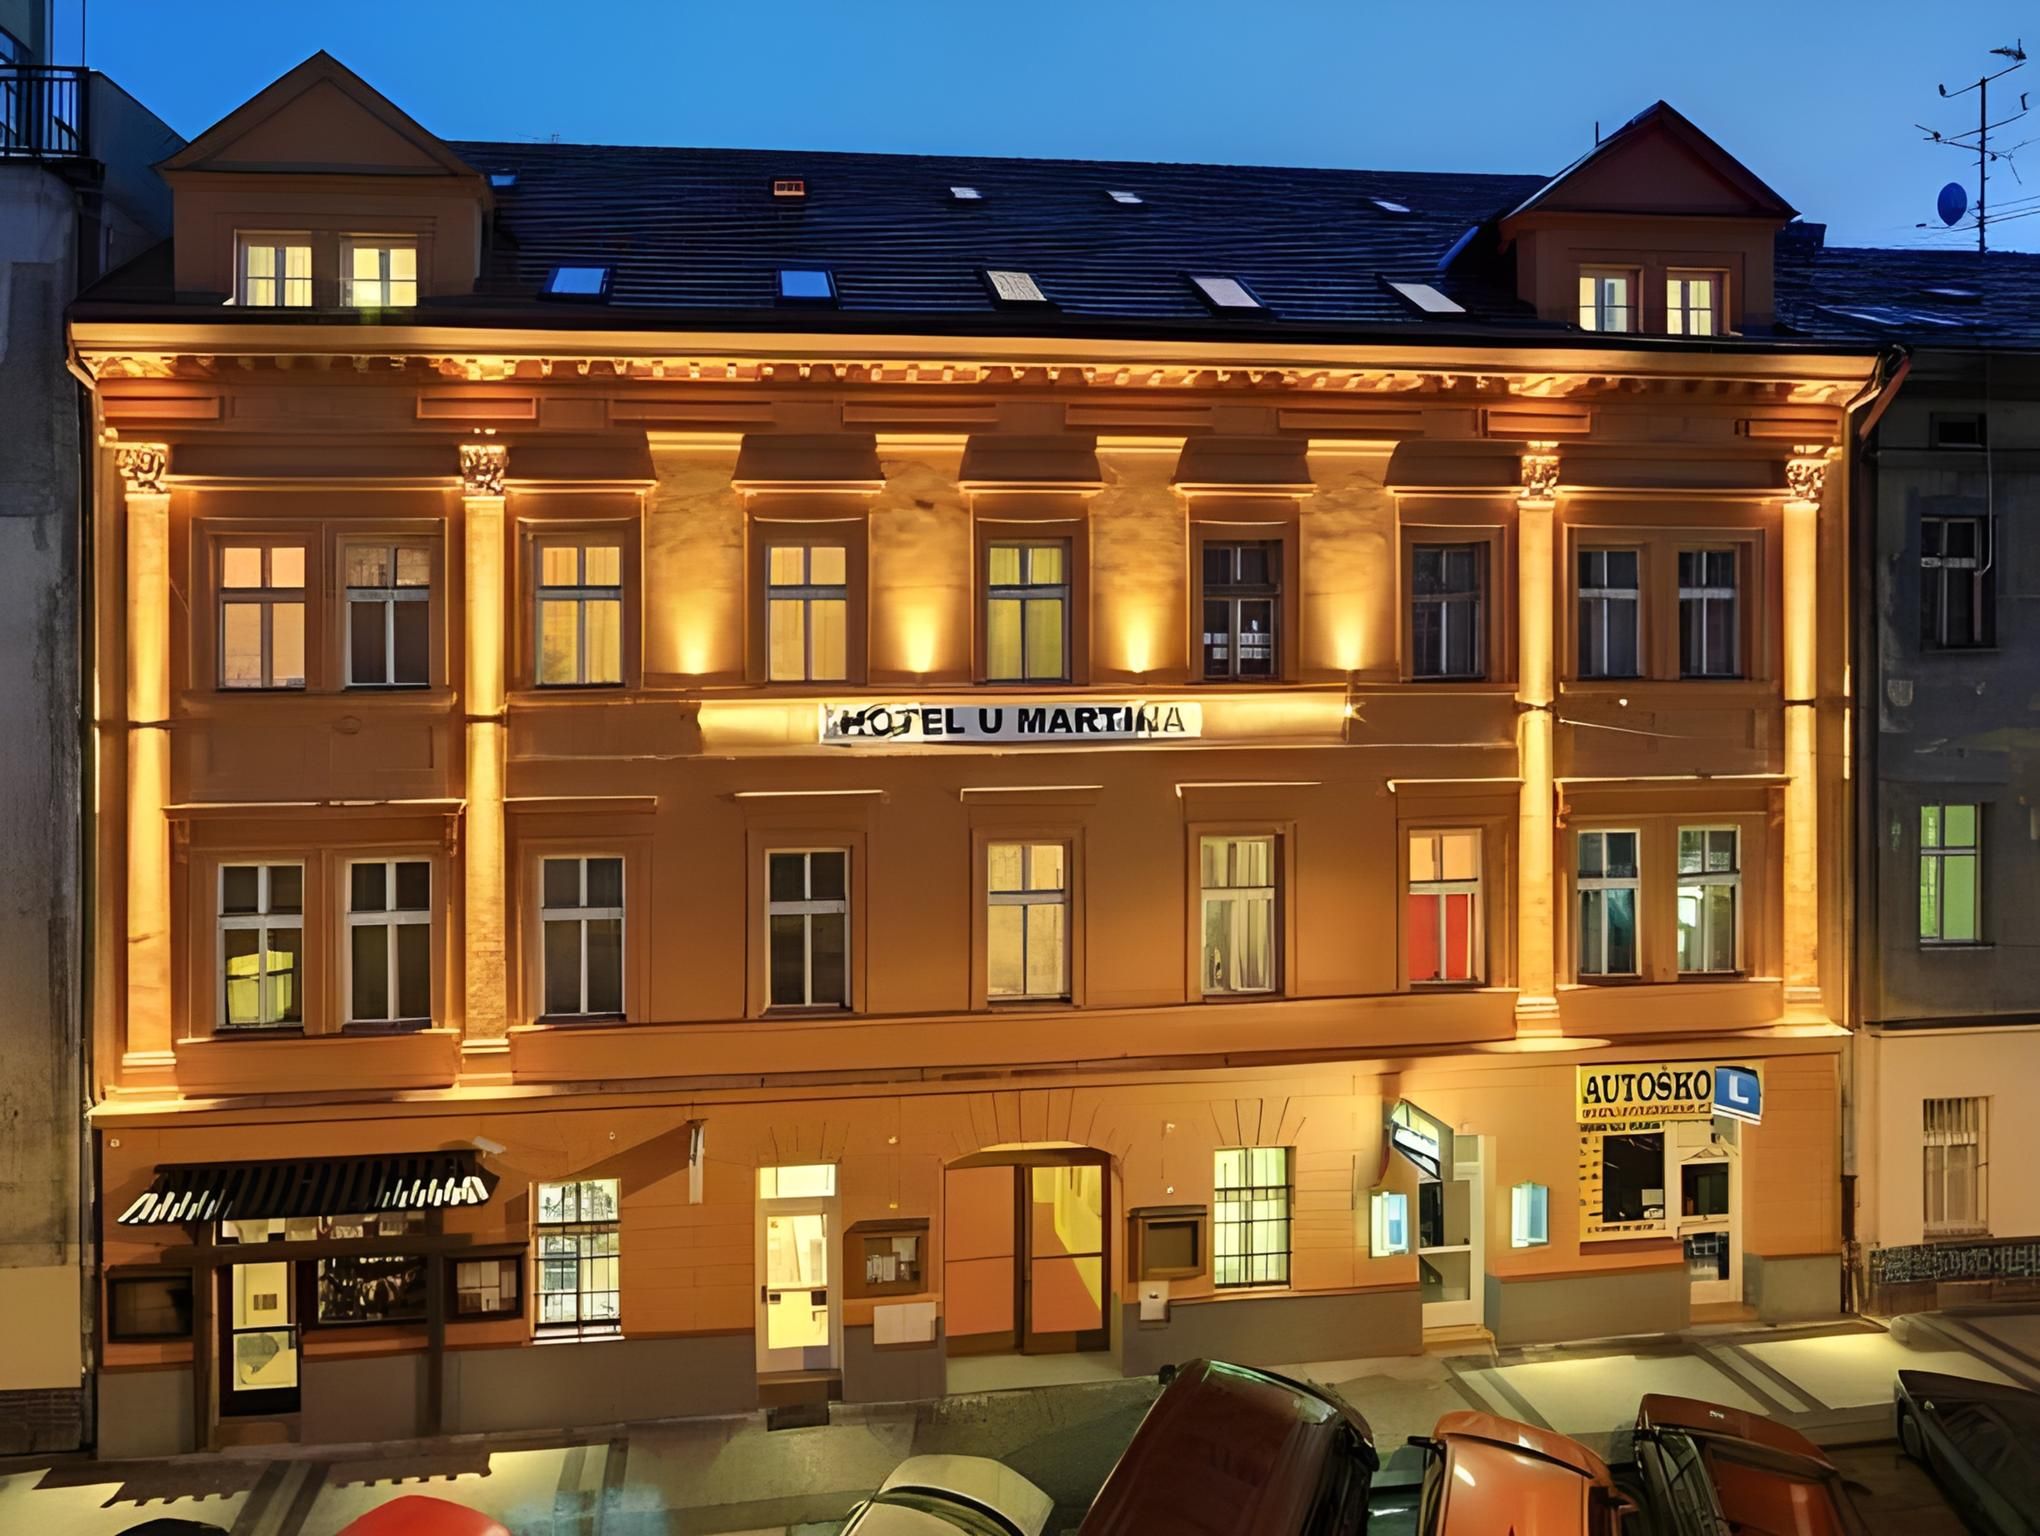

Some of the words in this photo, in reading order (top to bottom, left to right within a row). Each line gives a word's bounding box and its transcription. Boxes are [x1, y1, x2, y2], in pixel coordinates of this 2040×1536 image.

[839, 706, 967, 737] HOTEL
[978, 707, 1004, 734] U
[1017, 706, 1186, 733] MARTINA
[1729, 1074, 1749, 1105] L
